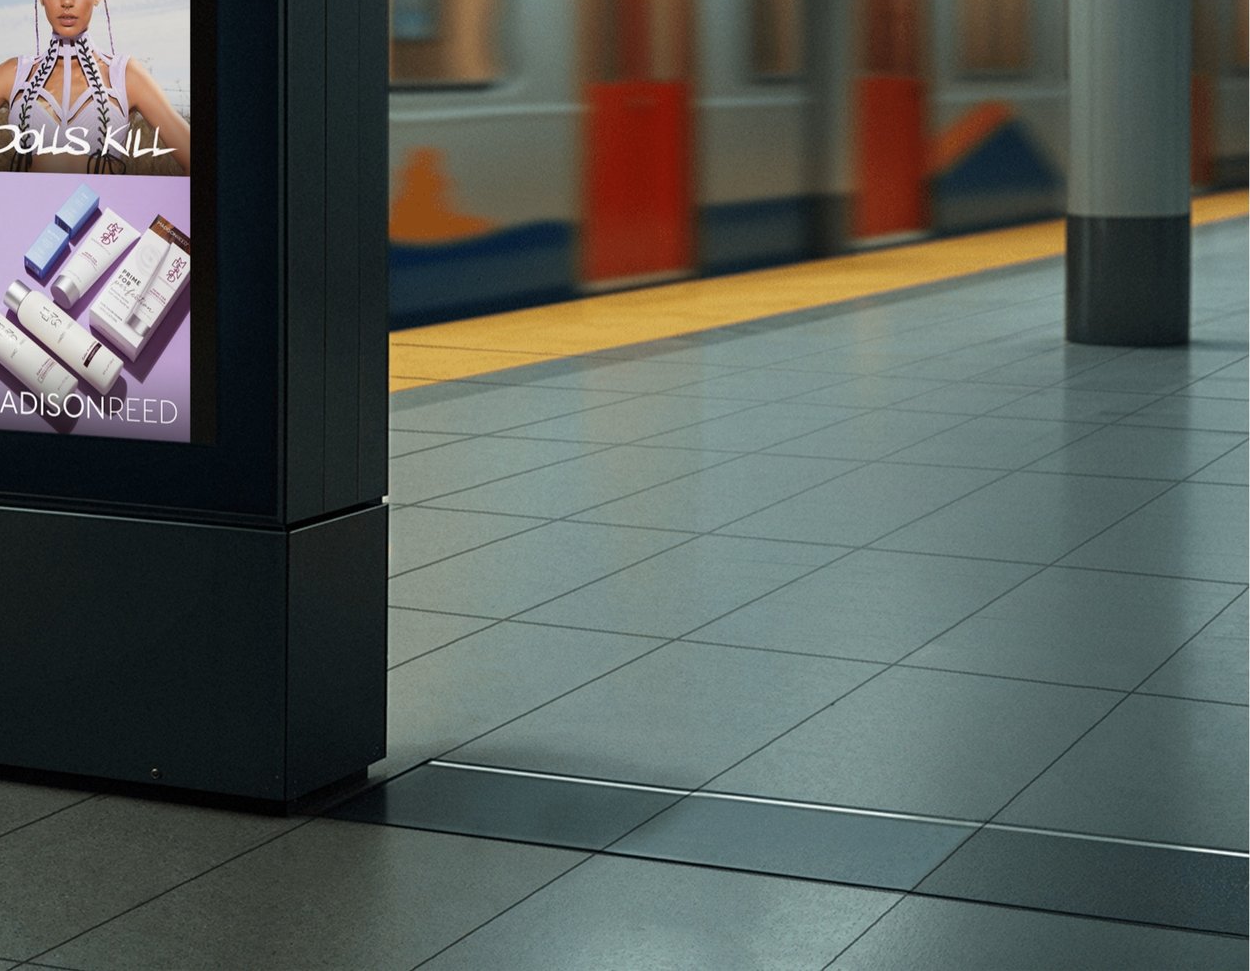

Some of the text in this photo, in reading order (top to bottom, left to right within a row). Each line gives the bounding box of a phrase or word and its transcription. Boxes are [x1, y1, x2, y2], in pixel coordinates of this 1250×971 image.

[101, 122, 178, 159] KILL
[117, 274, 132, 287] FOR
[121, 268, 142, 287] PRIME
